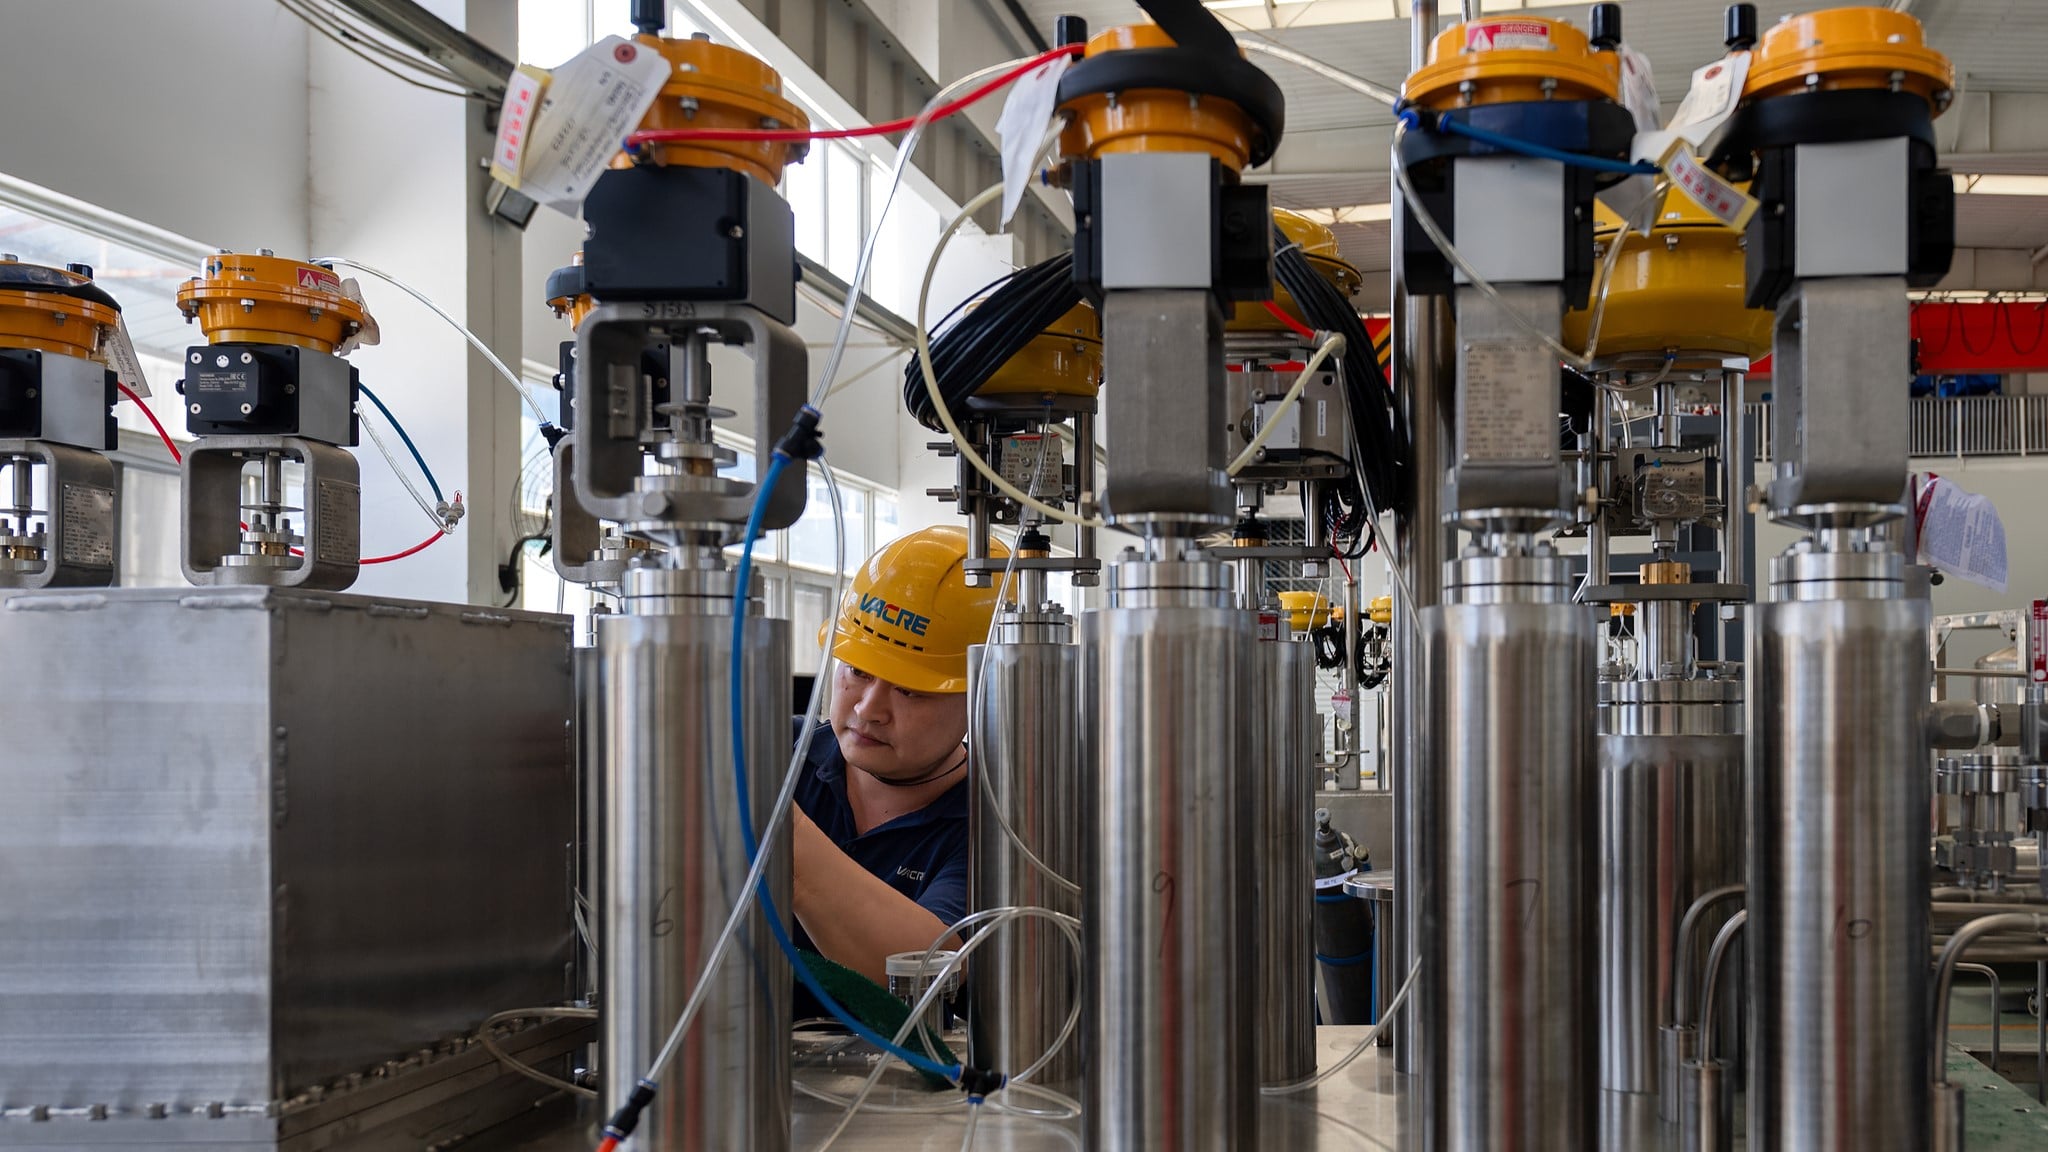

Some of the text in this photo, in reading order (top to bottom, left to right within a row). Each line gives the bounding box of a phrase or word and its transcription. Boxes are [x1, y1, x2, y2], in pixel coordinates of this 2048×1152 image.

[859, 592, 931, 637] VACRE
[896, 865, 925, 881] VACR
[650, 886, 675, 939] 6
[1505, 878, 1542, 929] 7
